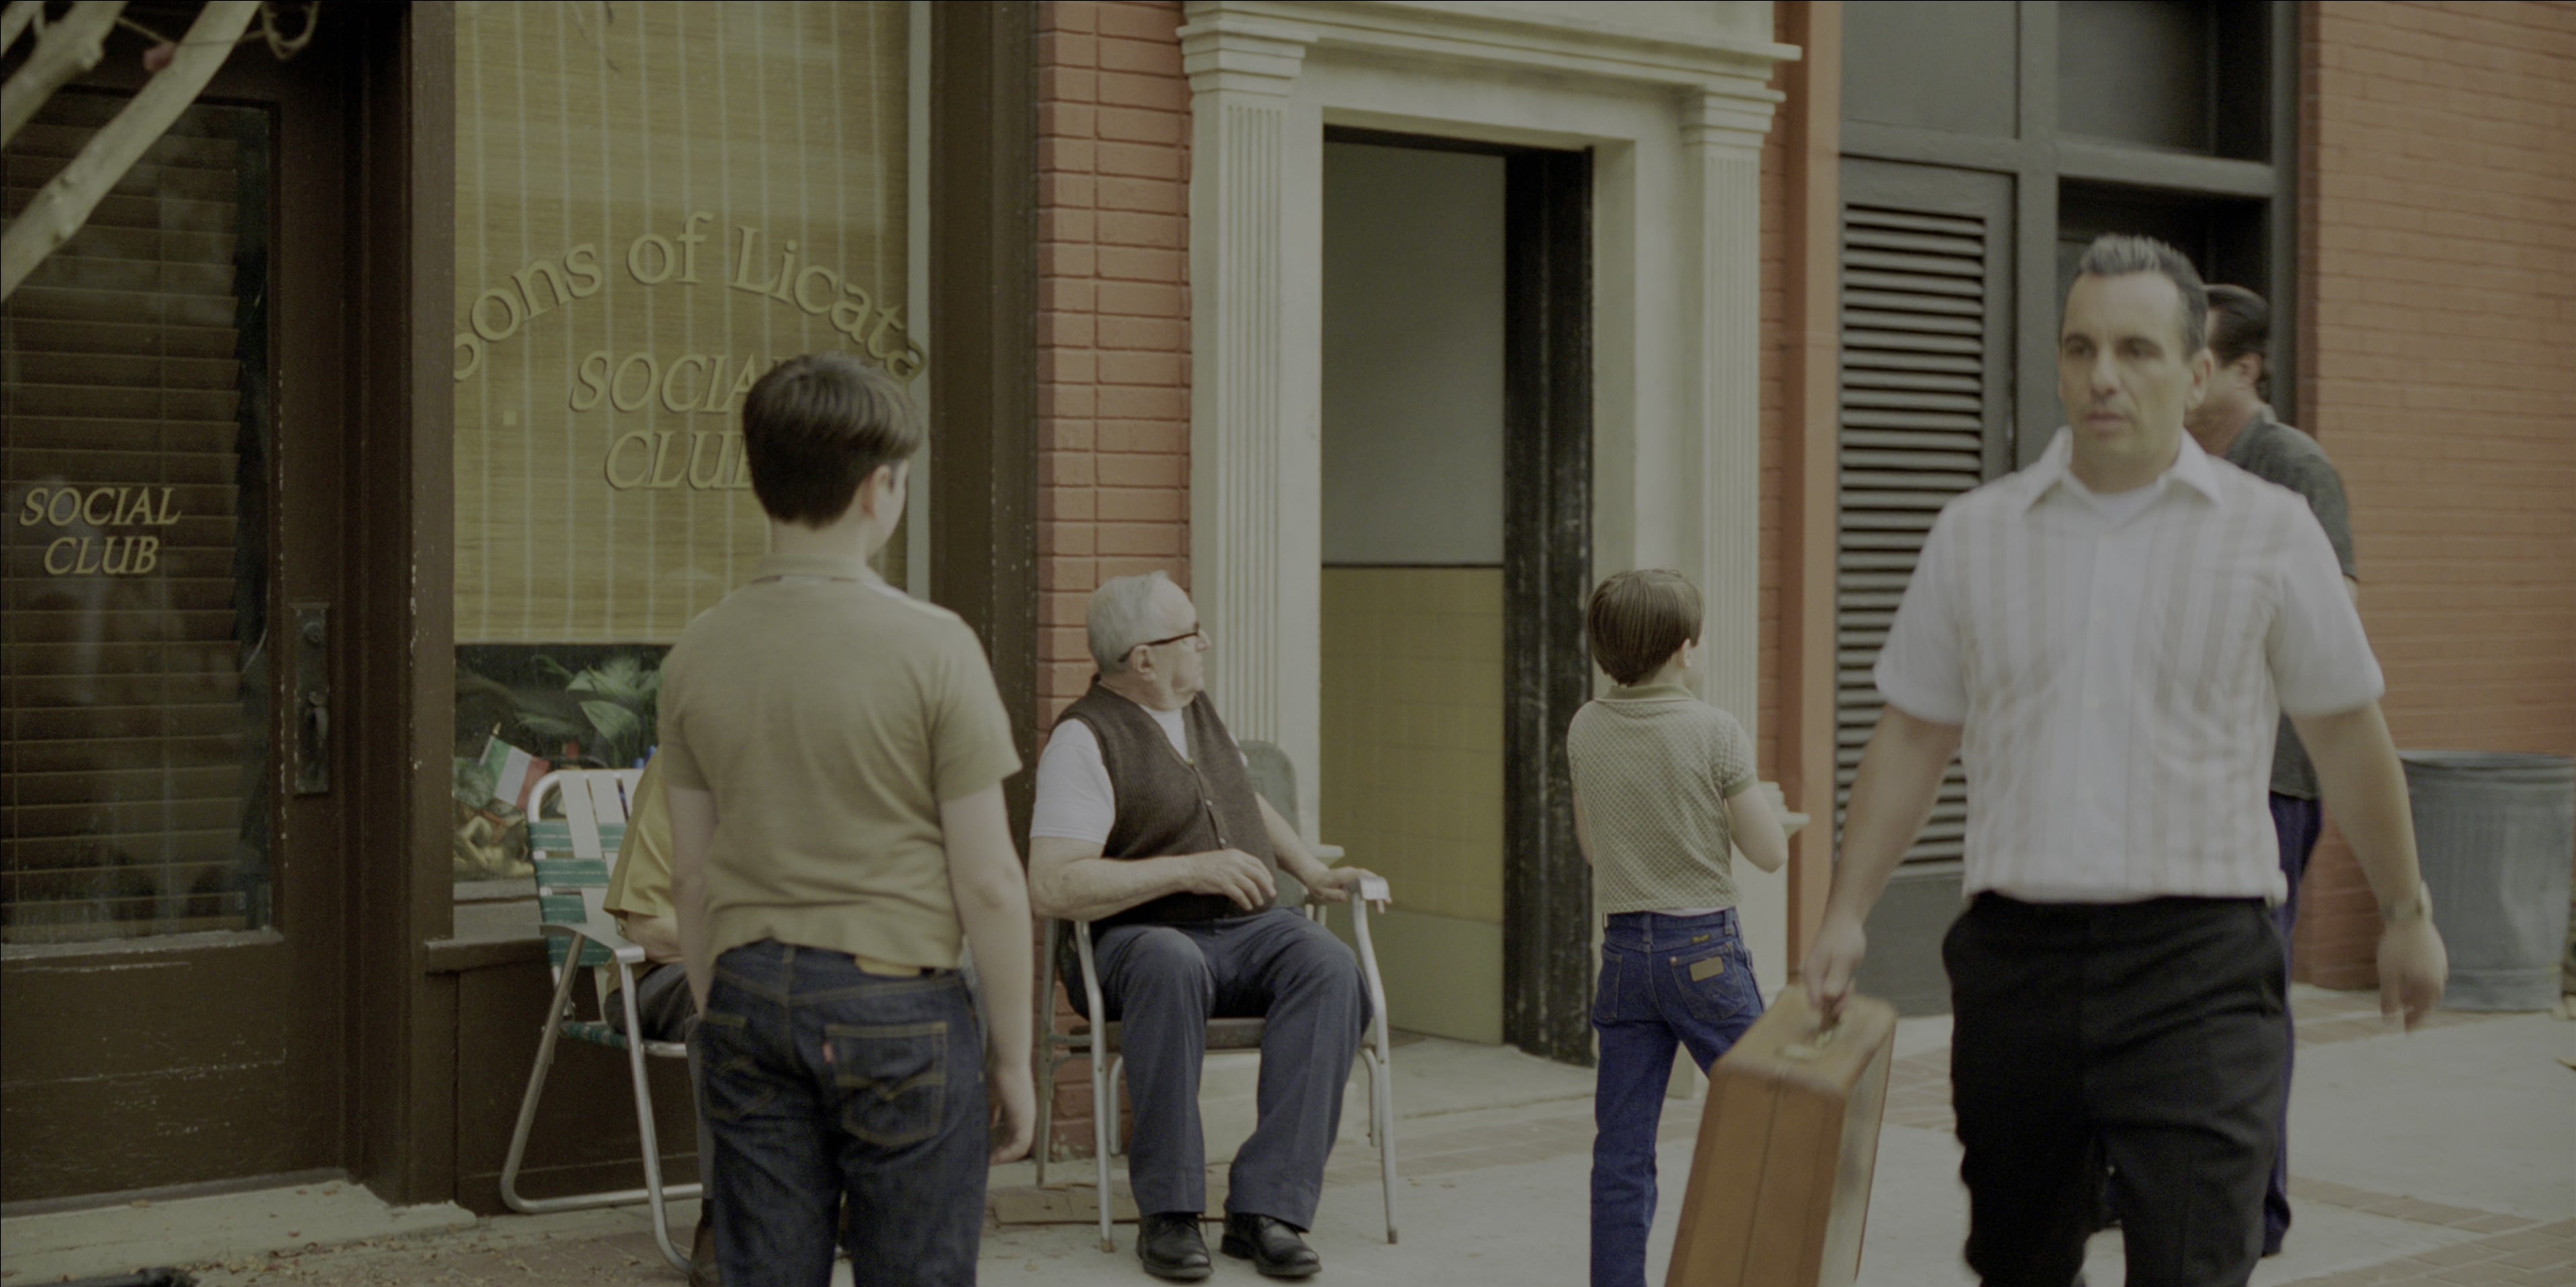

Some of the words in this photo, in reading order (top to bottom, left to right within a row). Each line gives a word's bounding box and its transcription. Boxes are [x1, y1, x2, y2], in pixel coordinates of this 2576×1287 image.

[628, 211, 715, 284] of
[729, 225, 926, 384] Licata
[571, 350, 792, 412] SOCIA
[19, 486, 181, 526] SOCIAL
[44, 536, 159, 574] CLUB
